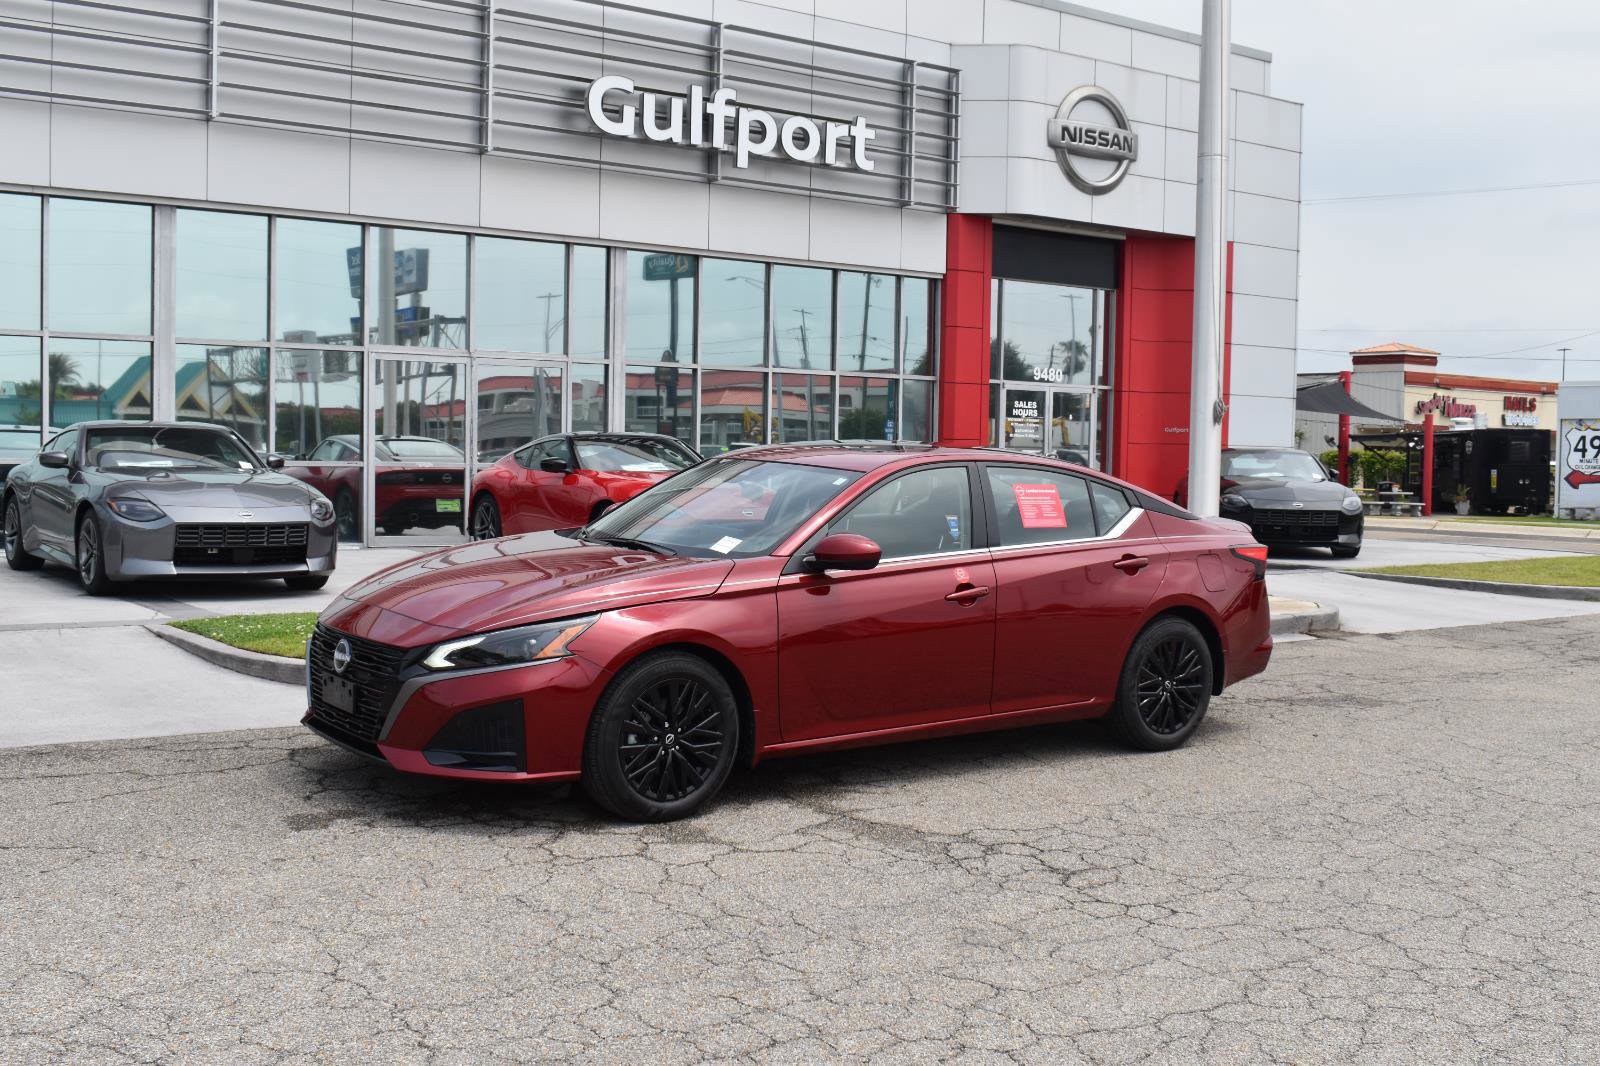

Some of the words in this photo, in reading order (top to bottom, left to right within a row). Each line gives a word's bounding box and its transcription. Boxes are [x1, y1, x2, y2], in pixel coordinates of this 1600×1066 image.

[585, 75, 876, 170] Gulfport
[1061, 125, 1133, 153] NISSAN
[1033, 366, 1063, 381] 9480
[1012, 408, 1038, 416] HOURS
[1014, 400, 1037, 409] SALES
[1503, 396, 1537, 412] NAILS
[1573, 435, 1600, 458] 49
